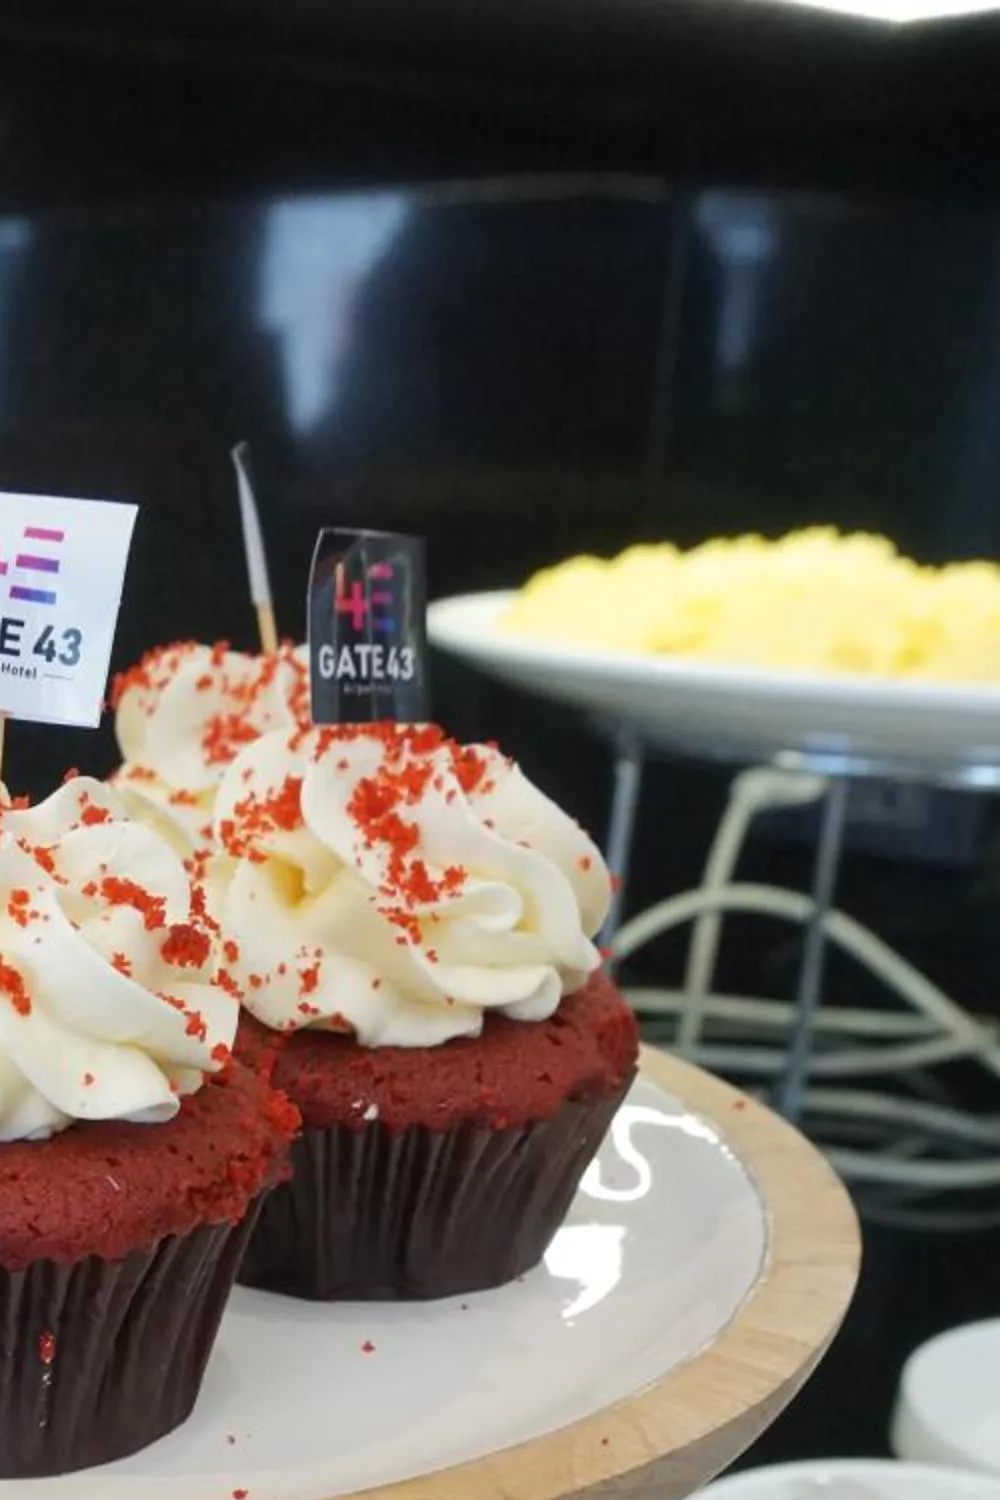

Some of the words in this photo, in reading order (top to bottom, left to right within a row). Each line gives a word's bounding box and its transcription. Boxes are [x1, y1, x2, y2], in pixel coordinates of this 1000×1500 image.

[32, 624, 84, 668] 43
[318, 643, 385, 680] GATE
[386, 645, 415, 681] 43
[1, 662, 38, 680] Hotel
